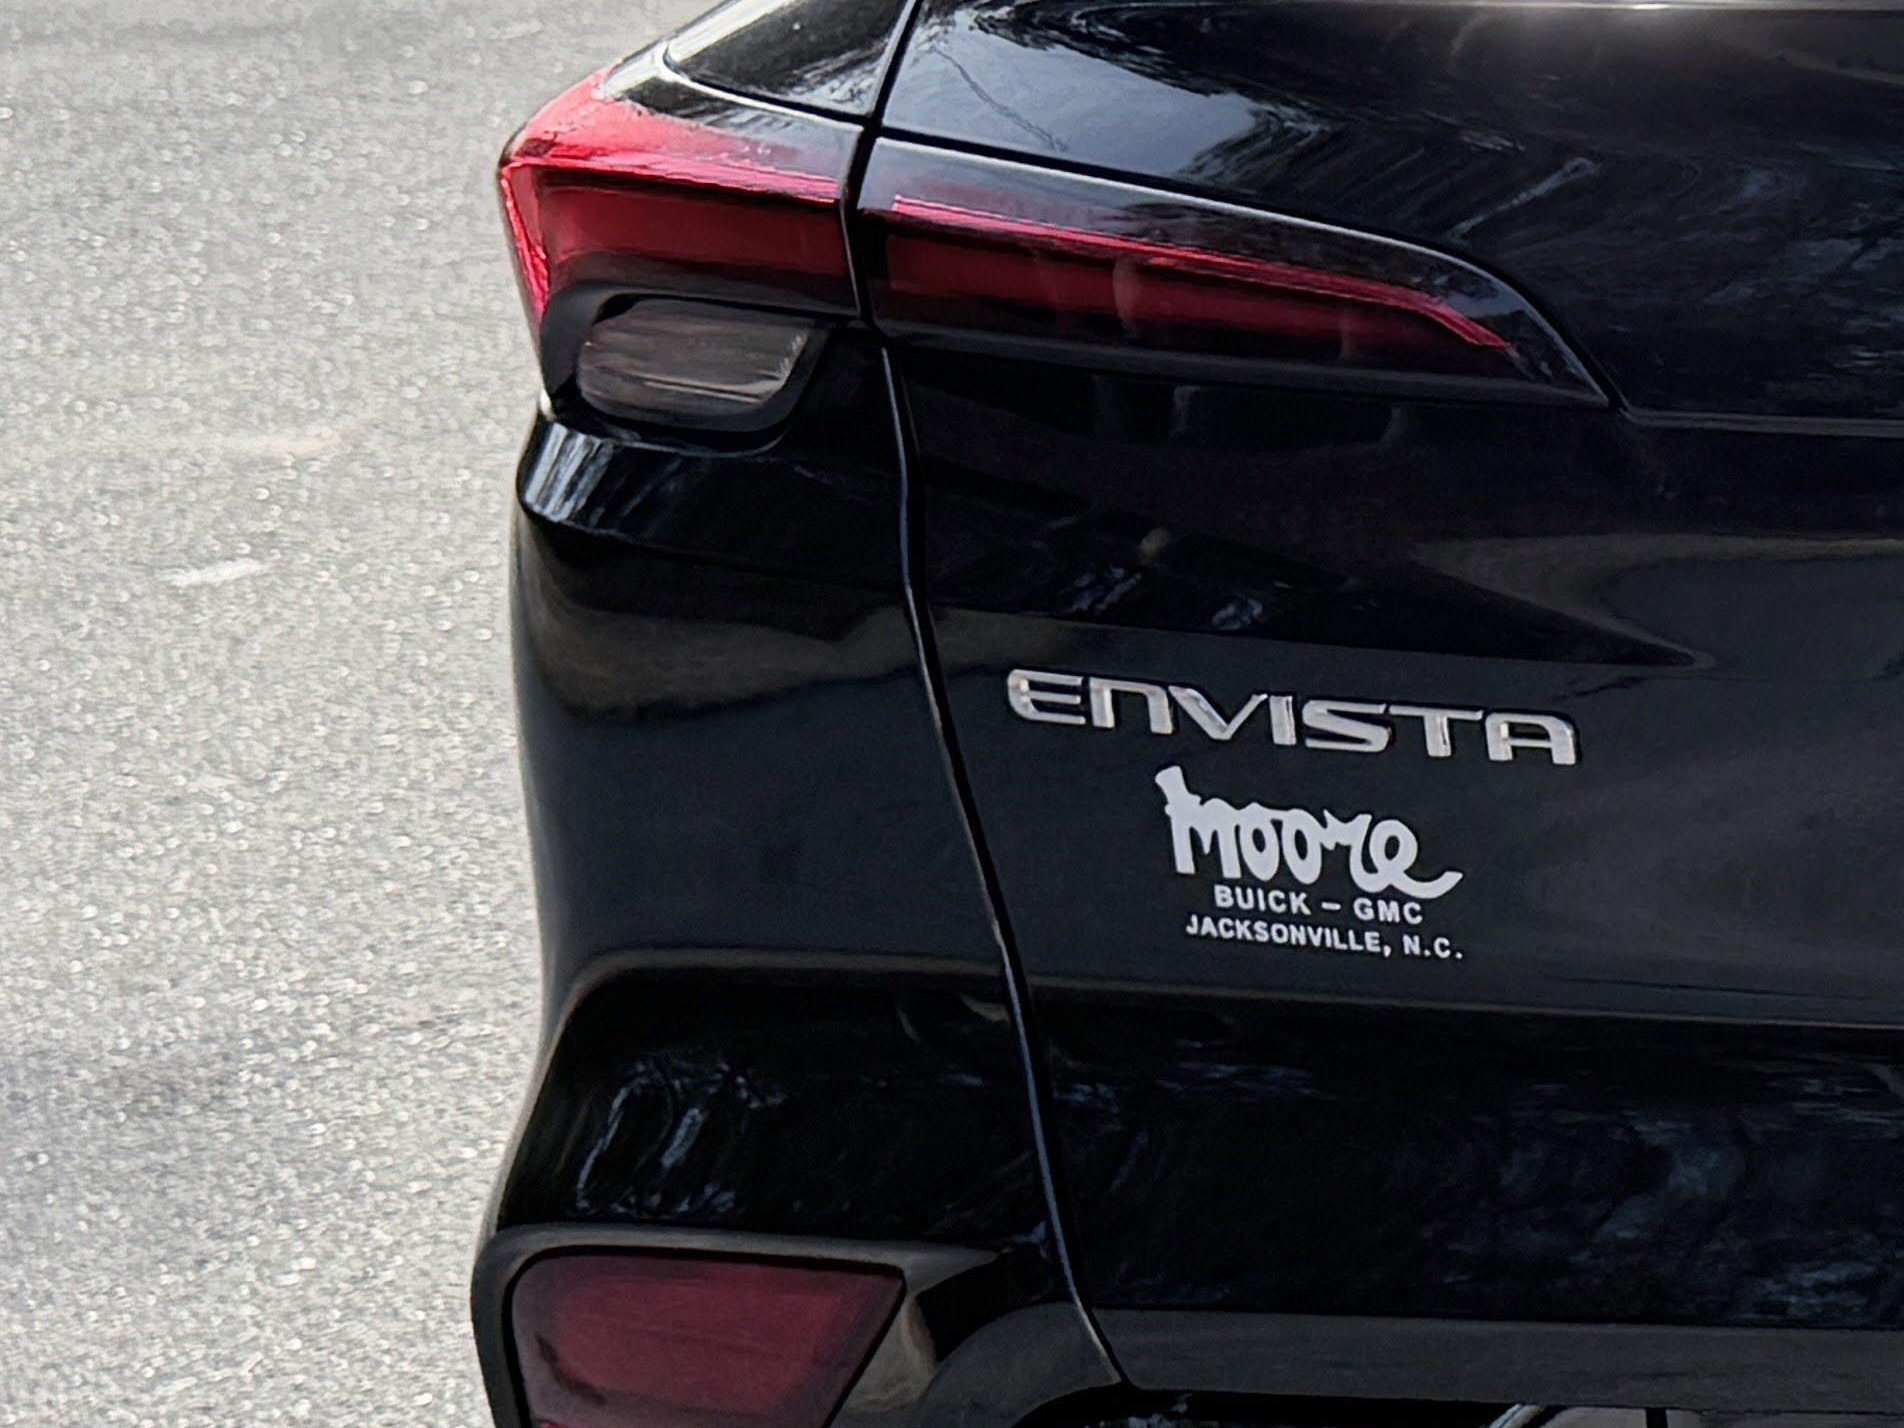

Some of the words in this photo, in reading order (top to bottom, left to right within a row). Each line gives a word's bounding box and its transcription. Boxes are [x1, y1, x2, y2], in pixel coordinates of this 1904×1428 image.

[1007, 669, 1578, 765] ENVISTA
[1213, 884, 1312, 915] BUICK
[1353, 897, 1423, 924] GMC
[1186, 914, 1392, 957] JACKSONVILLE,
[1403, 935, 1463, 959] N.C.
